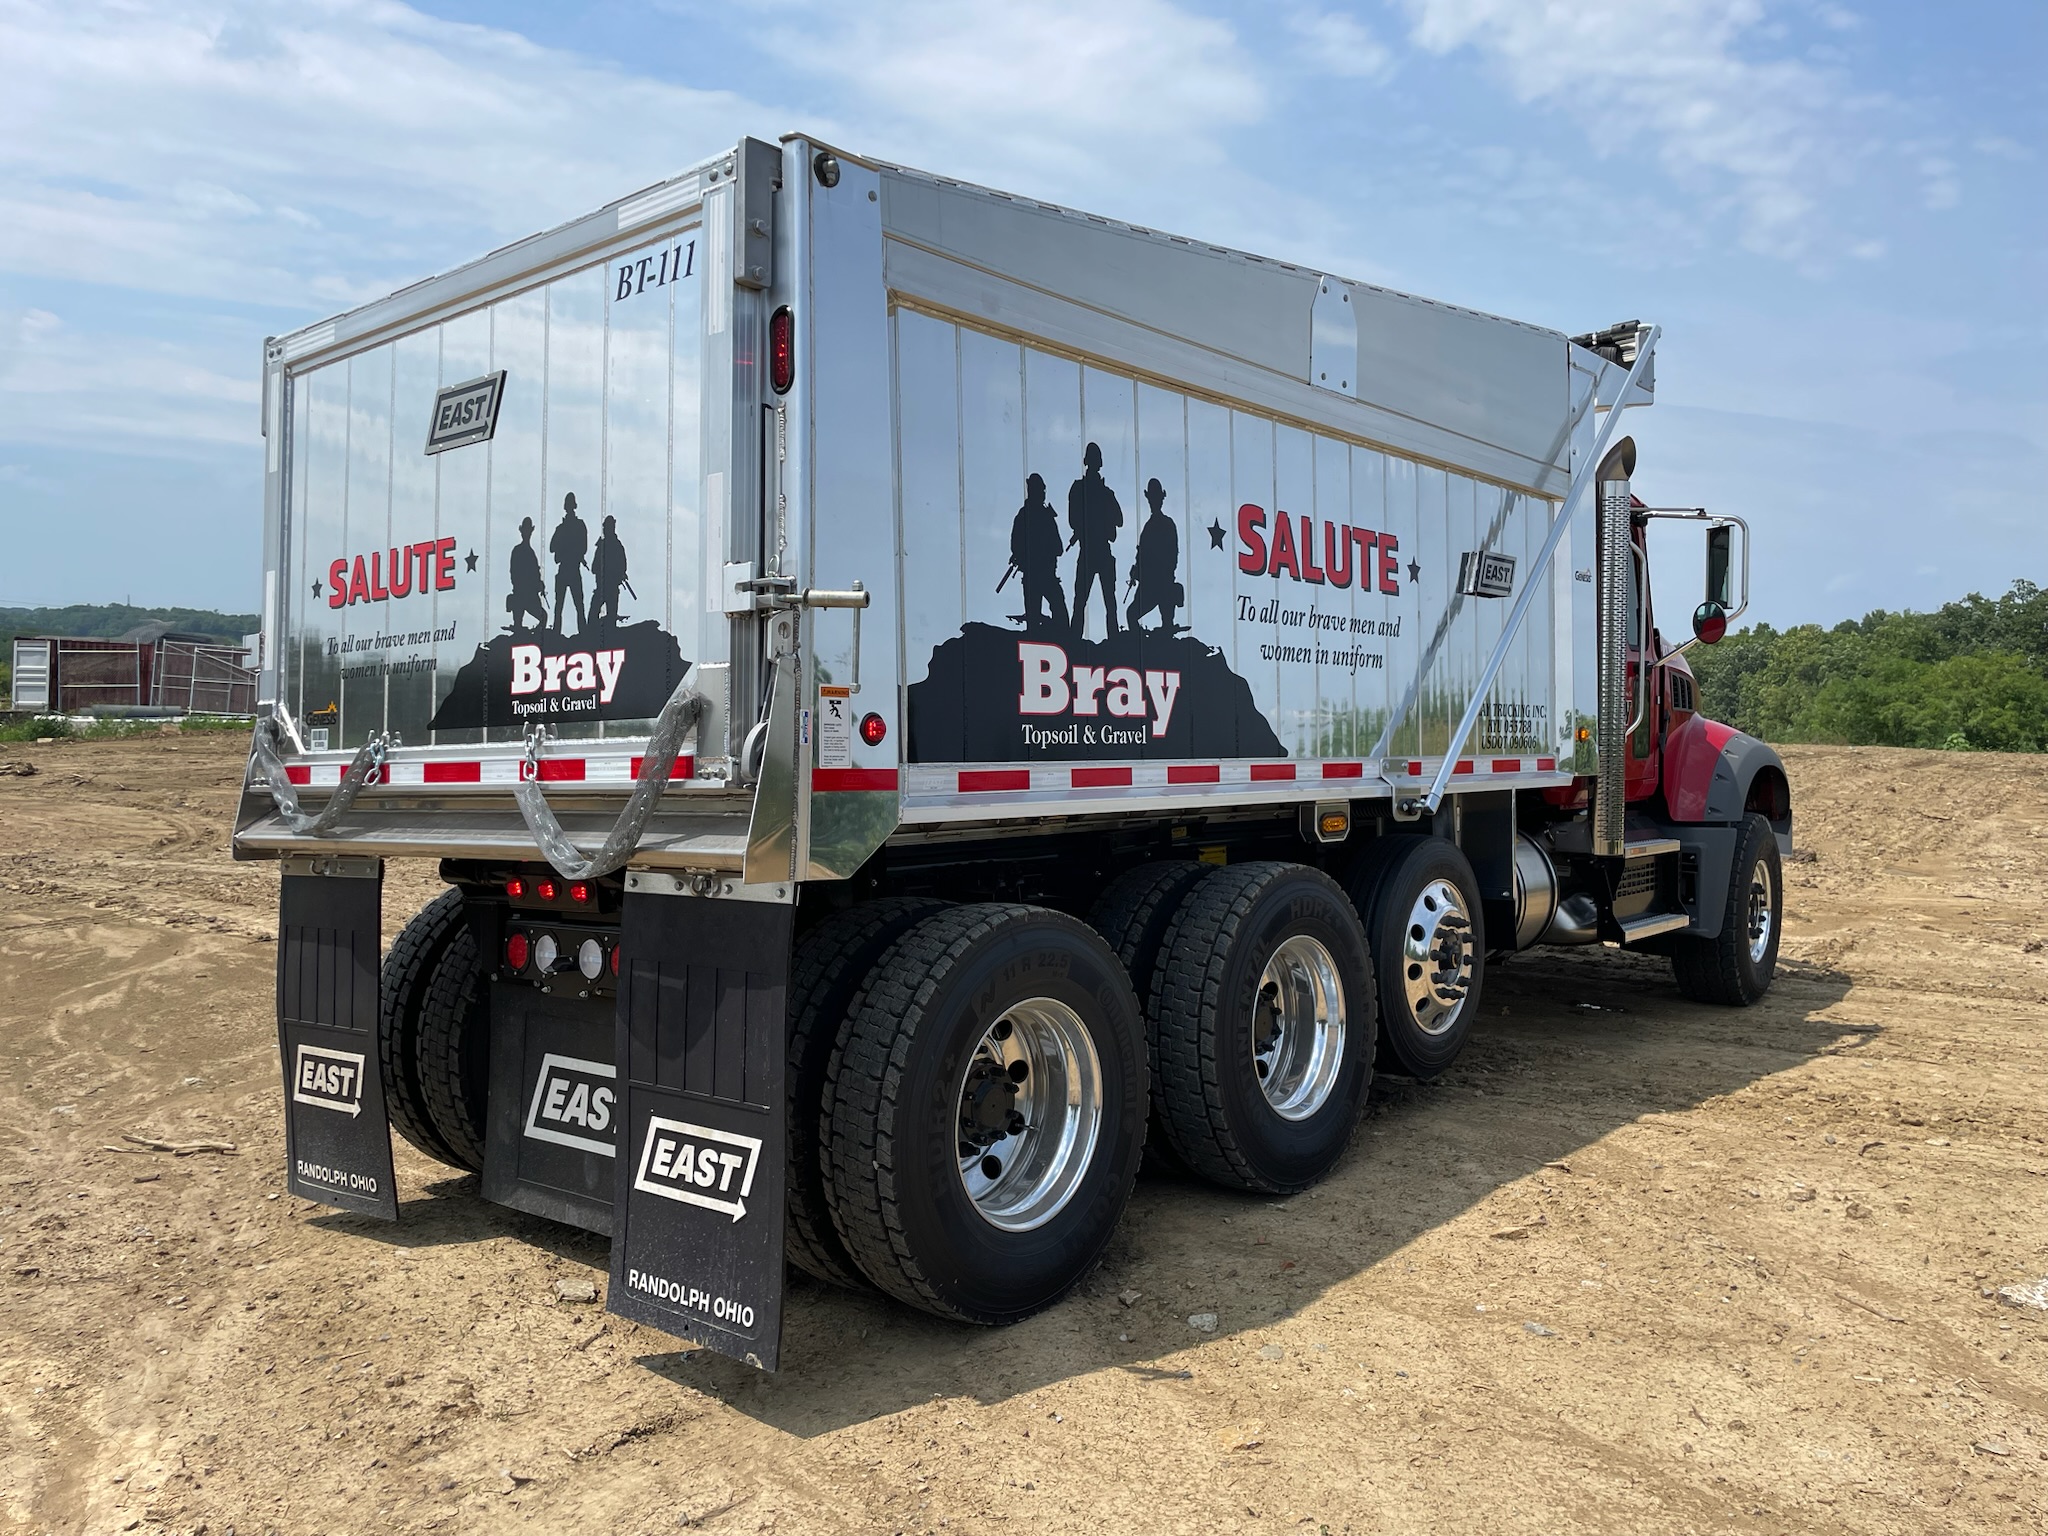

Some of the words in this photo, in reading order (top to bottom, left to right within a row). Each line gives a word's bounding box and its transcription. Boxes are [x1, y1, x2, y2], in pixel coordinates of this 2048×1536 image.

[615, 239, 696, 302] BT-111
[437, 395, 488, 432] EAST
[1237, 503, 1400, 597] SALUTE
[328, 536, 456, 610] SALUTE
[1485, 563, 1511, 583] EAST
[1237, 594, 1257, 622] To
[1259, 599, 1280, 625] all
[1281, 609, 1307, 627] our
[1308, 604, 1347, 632] brave
[1349, 617, 1376, 635] men
[1378, 616, 1402, 638] and
[327, 636, 340, 656] To
[340, 634, 355, 654] all
[355, 637, 374, 652] our
[374, 630, 406, 650] brave
[407, 630, 431, 646] men
[433, 620, 457, 643] and
[340, 664, 377, 680] women
[379, 658, 390, 676] in
[392, 653, 438, 681] uniform
[510, 643, 626, 705] Bray
[1260, 643, 1312, 664] women
[1315, 641, 1329, 666] in
[1332, 644, 1383, 677] uniform
[511, 697, 548, 718] Topsoil
[549, 697, 560, 713] &
[561, 693, 597, 712] Gravel
[1017, 640, 1182, 738] Bray
[1493, 703, 1531, 718] TRUCKING
[1532, 704, 1547, 719] INC.
[1021, 723, 1079, 749] Topsoil
[1082, 724, 1098, 745] &
[1100, 724, 1148, 745] Gravel
[1481, 736, 1508, 750] USDOT
[301, 1060, 356, 1097] EAST
[541, 1077, 616, 1132] EAS
[297, 1160, 348, 1187] RANDOLPH
[350, 1173, 378, 1193] OHIO
[649, 1137, 744, 1194] EAST
[628, 1268, 711, 1313] RANDOLPH
[713, 1296, 755, 1328] OHIO
